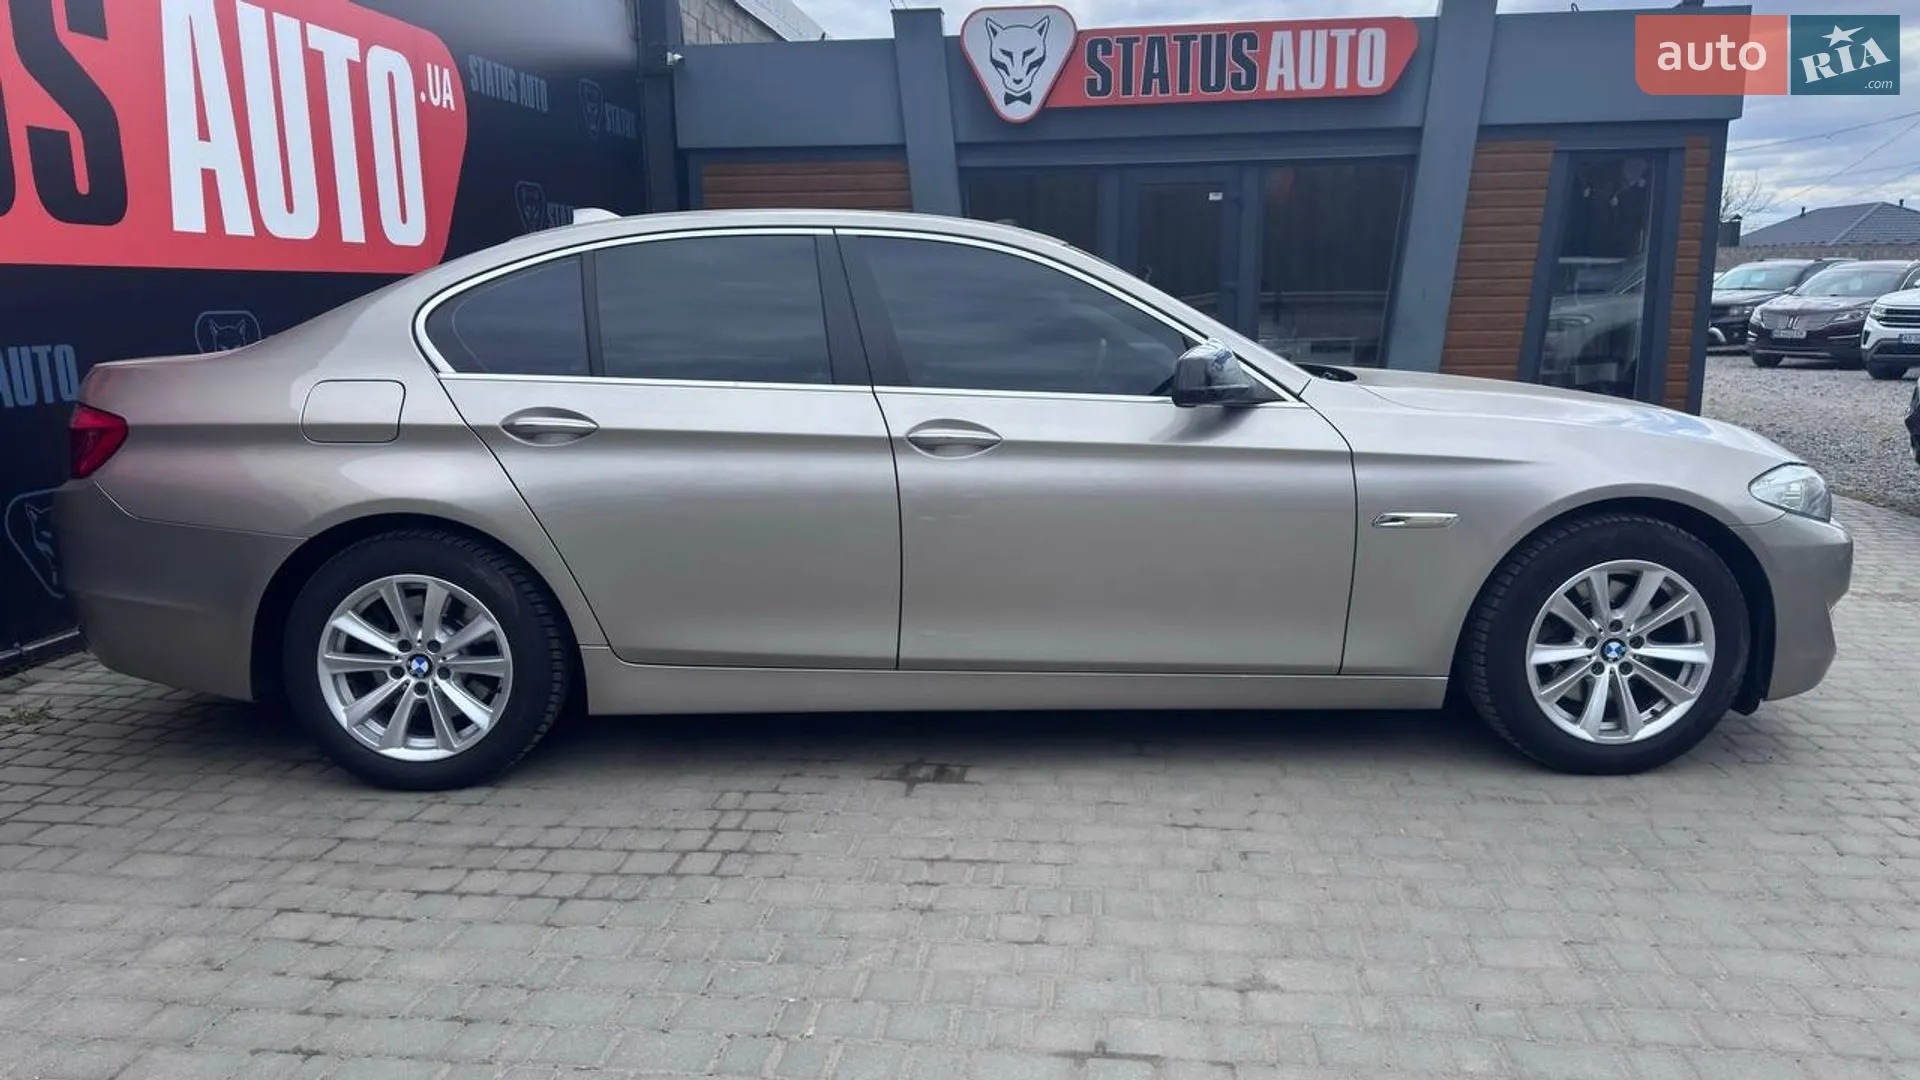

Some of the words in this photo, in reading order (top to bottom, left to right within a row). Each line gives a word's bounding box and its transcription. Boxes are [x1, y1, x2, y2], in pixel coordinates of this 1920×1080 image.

[468, 54, 518, 104] STATUS
[519, 71, 549, 112] AUTO
[1085, 31, 1261, 99] STATUS
[1265, 26, 1387, 92] AUTO
[0, 0, 128, 226] S
[161, 0, 427, 248] AUTO
